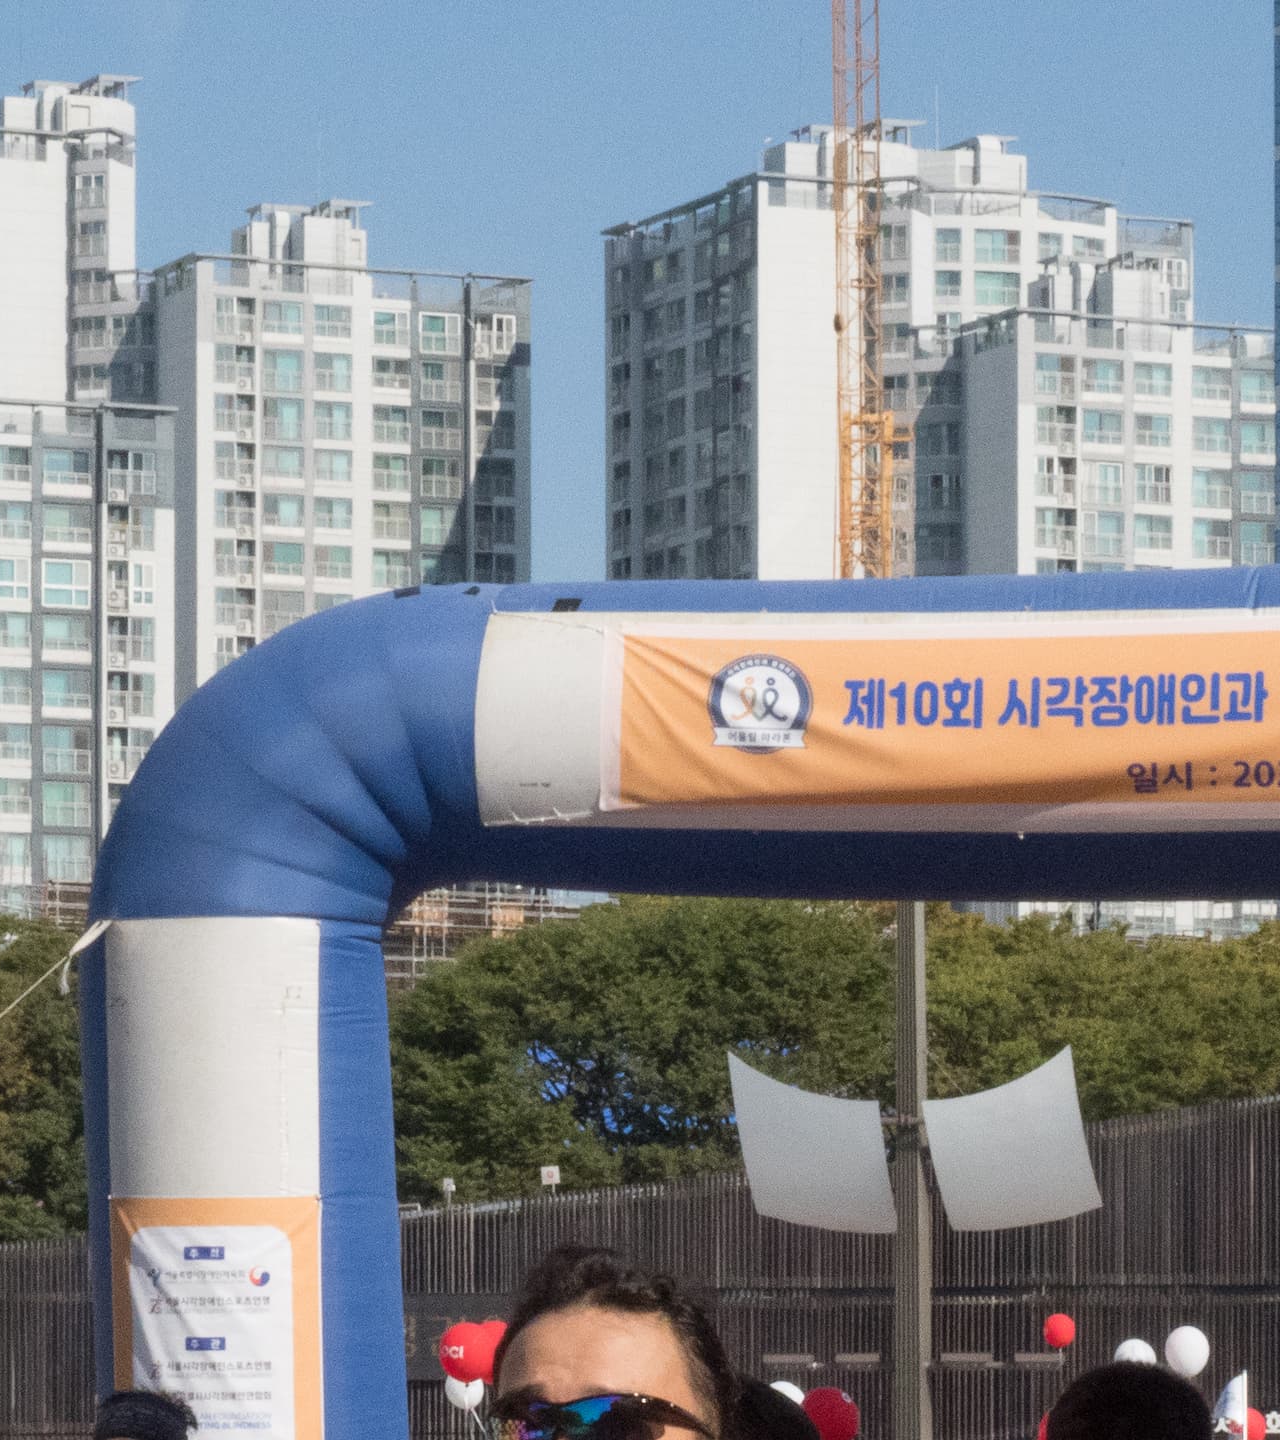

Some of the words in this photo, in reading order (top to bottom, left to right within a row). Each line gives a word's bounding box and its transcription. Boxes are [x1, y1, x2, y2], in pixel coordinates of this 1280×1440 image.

[843, 677, 983, 729] 제10회
[998, 671, 1269, 728] 시각장애인과
[1127, 761, 1193, 793] 일시
